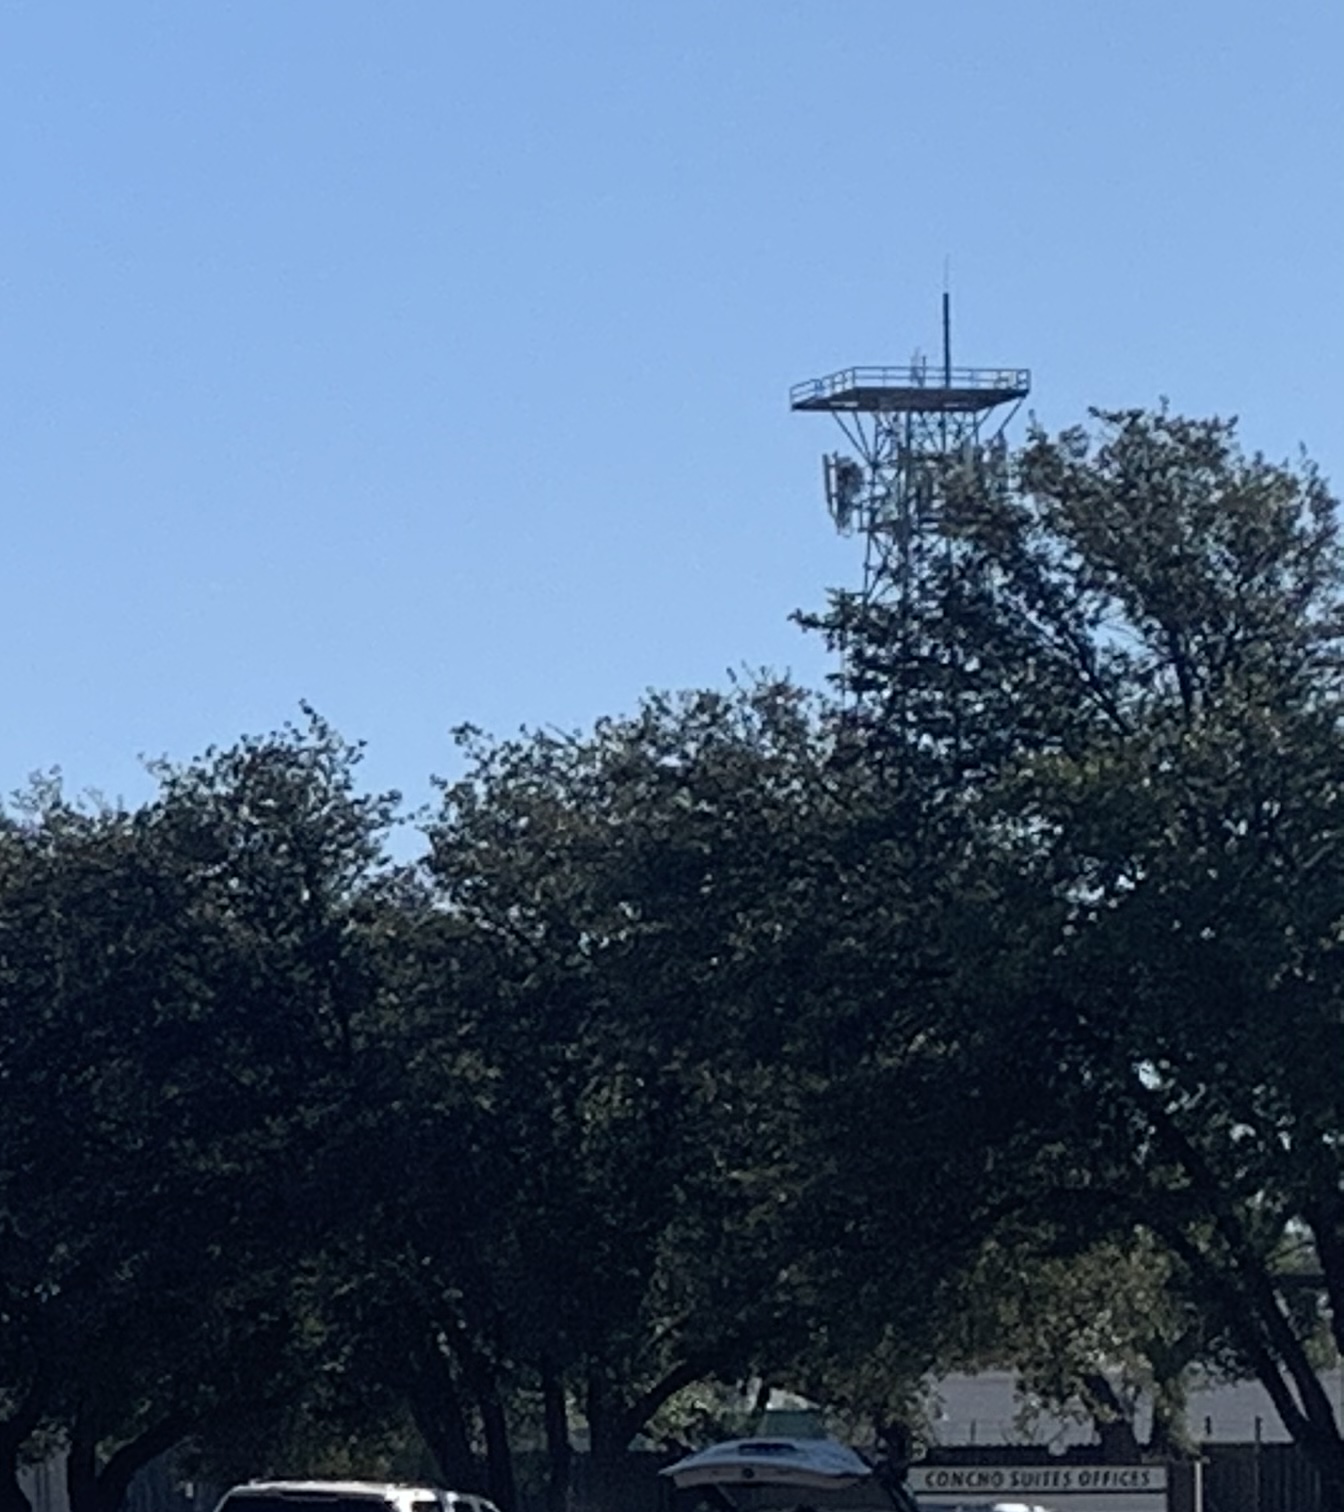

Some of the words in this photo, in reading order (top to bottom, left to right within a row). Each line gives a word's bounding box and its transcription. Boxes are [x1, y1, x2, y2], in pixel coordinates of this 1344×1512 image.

[924, 1470, 1005, 1488] CONCHO
[1012, 1470, 1072, 1487] SUITES
[1078, 1470, 1150, 1487] OFFICES
